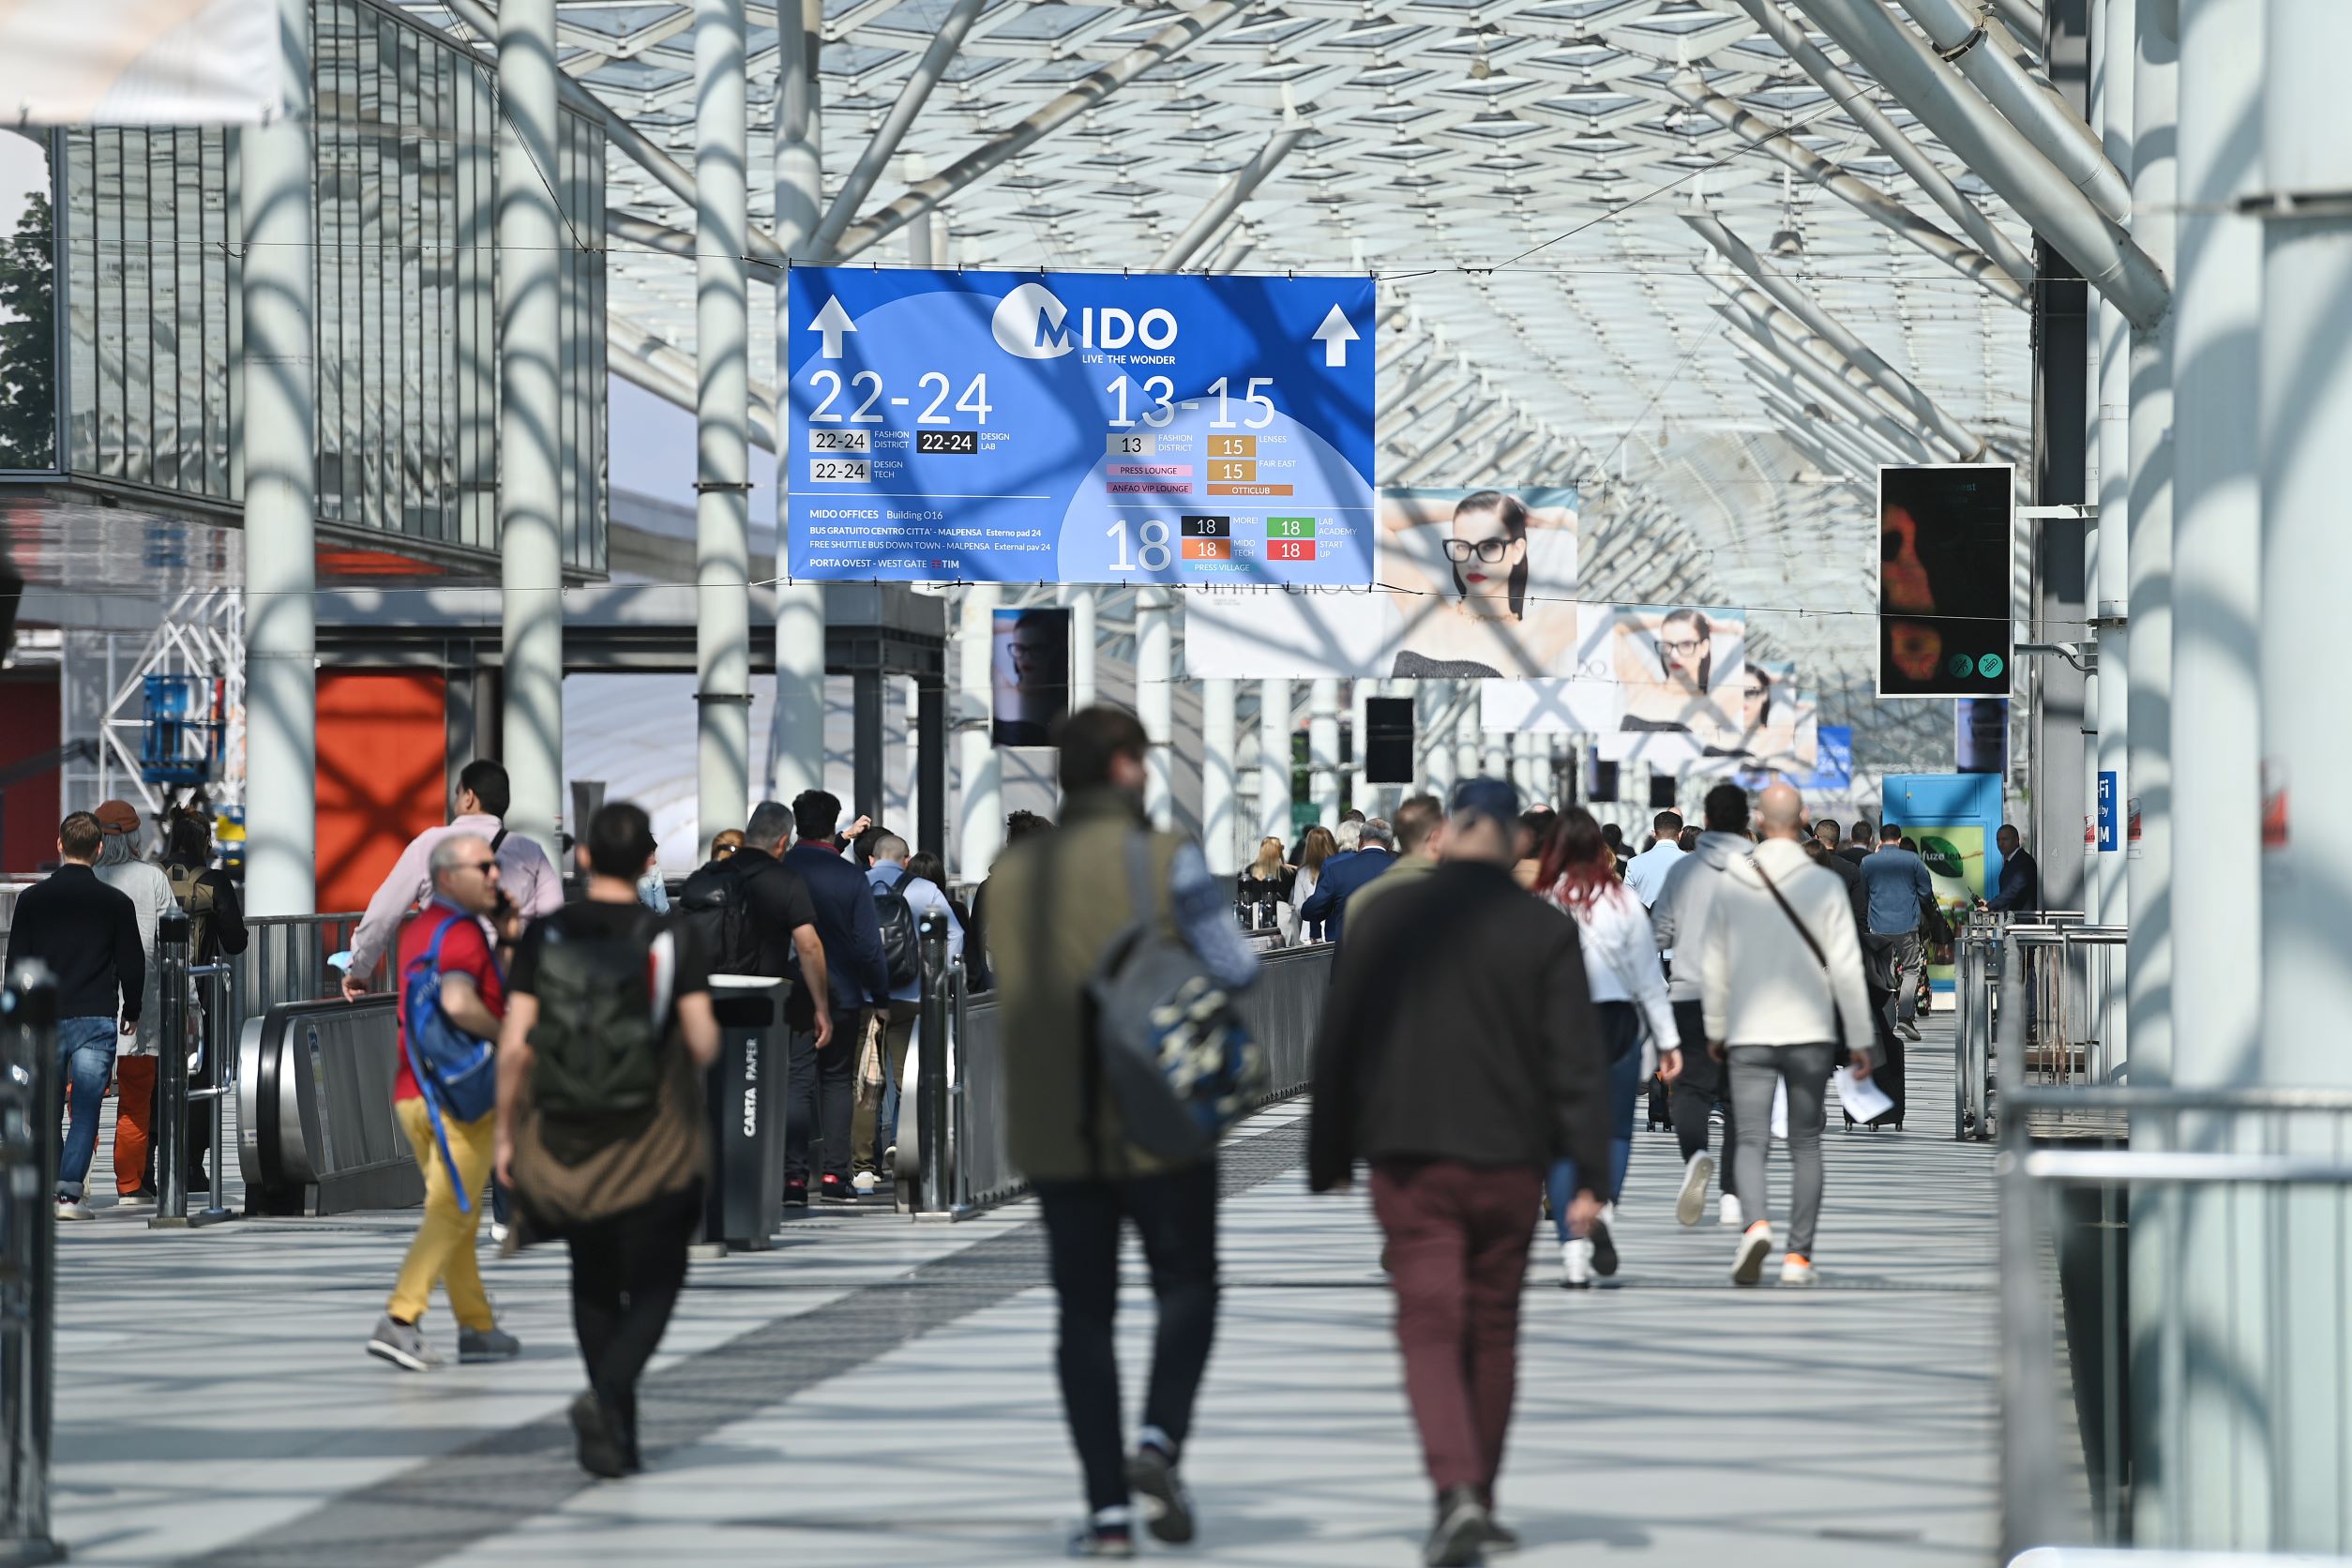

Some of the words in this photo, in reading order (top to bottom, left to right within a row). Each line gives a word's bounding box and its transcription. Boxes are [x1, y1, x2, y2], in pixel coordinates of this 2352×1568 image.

[1033, 306, 1178, 351] MIDO
[1082, 354, 1104, 364] LIVE
[1107, 355, 1126, 364] THE
[1130, 355, 1176, 365] WONDER
[808, 369, 993, 425] 22-24
[1106, 375, 1275, 430] 13-15
[816, 432, 866, 448] 22-24
[874, 430, 910, 439] FASHION
[981, 432, 1010, 441] DESIGN
[874, 441, 910, 449] DISTRICT
[922, 434, 972, 450] 22-24
[1122, 437, 1141, 453] 13
[1223, 439, 1244, 455] 15
[874, 460, 903, 469] DESIGN
[1259, 460, 1276, 468] FAIR
[1277, 460, 1296, 468] EAST
[816, 463, 866, 479] 22-24
[1120, 466, 1143, 475] PRESS
[1223, 463, 1244, 479] 15
[1112, 484, 1140, 492] ANFAO
[1155, 485, 1189, 493] LOUNGE
[1231, 487, 1271, 495] OTTICLUB
[809, 509, 837, 519] MIDO
[838, 509, 879, 520] OFFICES
[886, 510, 922, 521] Building
[809, 526, 826, 535] BUS
[826, 526, 870, 535] GRATUITO
[870, 527, 905, 535] CENTRO
[906, 527, 932, 535] CITTA'
[938, 528, 982, 536] MALPENSA
[986, 528, 1016, 536] Esterno
[1016, 529, 1030, 538] pad
[1031, 529, 1042, 537] 24
[1197, 519, 1216, 535] 18
[1281, 520, 1301, 535] 18
[1318, 527, 1358, 535] ACADEMY
[809, 540, 830, 549] FREE
[831, 540, 867, 549] SHUTTLE
[885, 541, 913, 550] DOWN
[914, 541, 941, 550] TOWN
[946, 542, 990, 550] MALPENSA
[994, 542, 1025, 550] External
[1026, 544, 1040, 552] pav
[1040, 543, 1050, 551] 24
[1106, 520, 1171, 572] 18
[1198, 541, 1217, 557] 18
[1281, 542, 1301, 558] 18
[1319, 540, 1344, 549] START
[809, 559, 840, 567] PORTA
[841, 559, 872, 567] OVEST
[878, 559, 902, 567] WEST
[903, 560, 927, 568] GATE
[942, 560, 959, 568] TIM
[1218, 564, 1250, 572] VILLAGE
[745, 1037, 758, 1080] PAPER
[743, 1087, 757, 1138] CARTA
